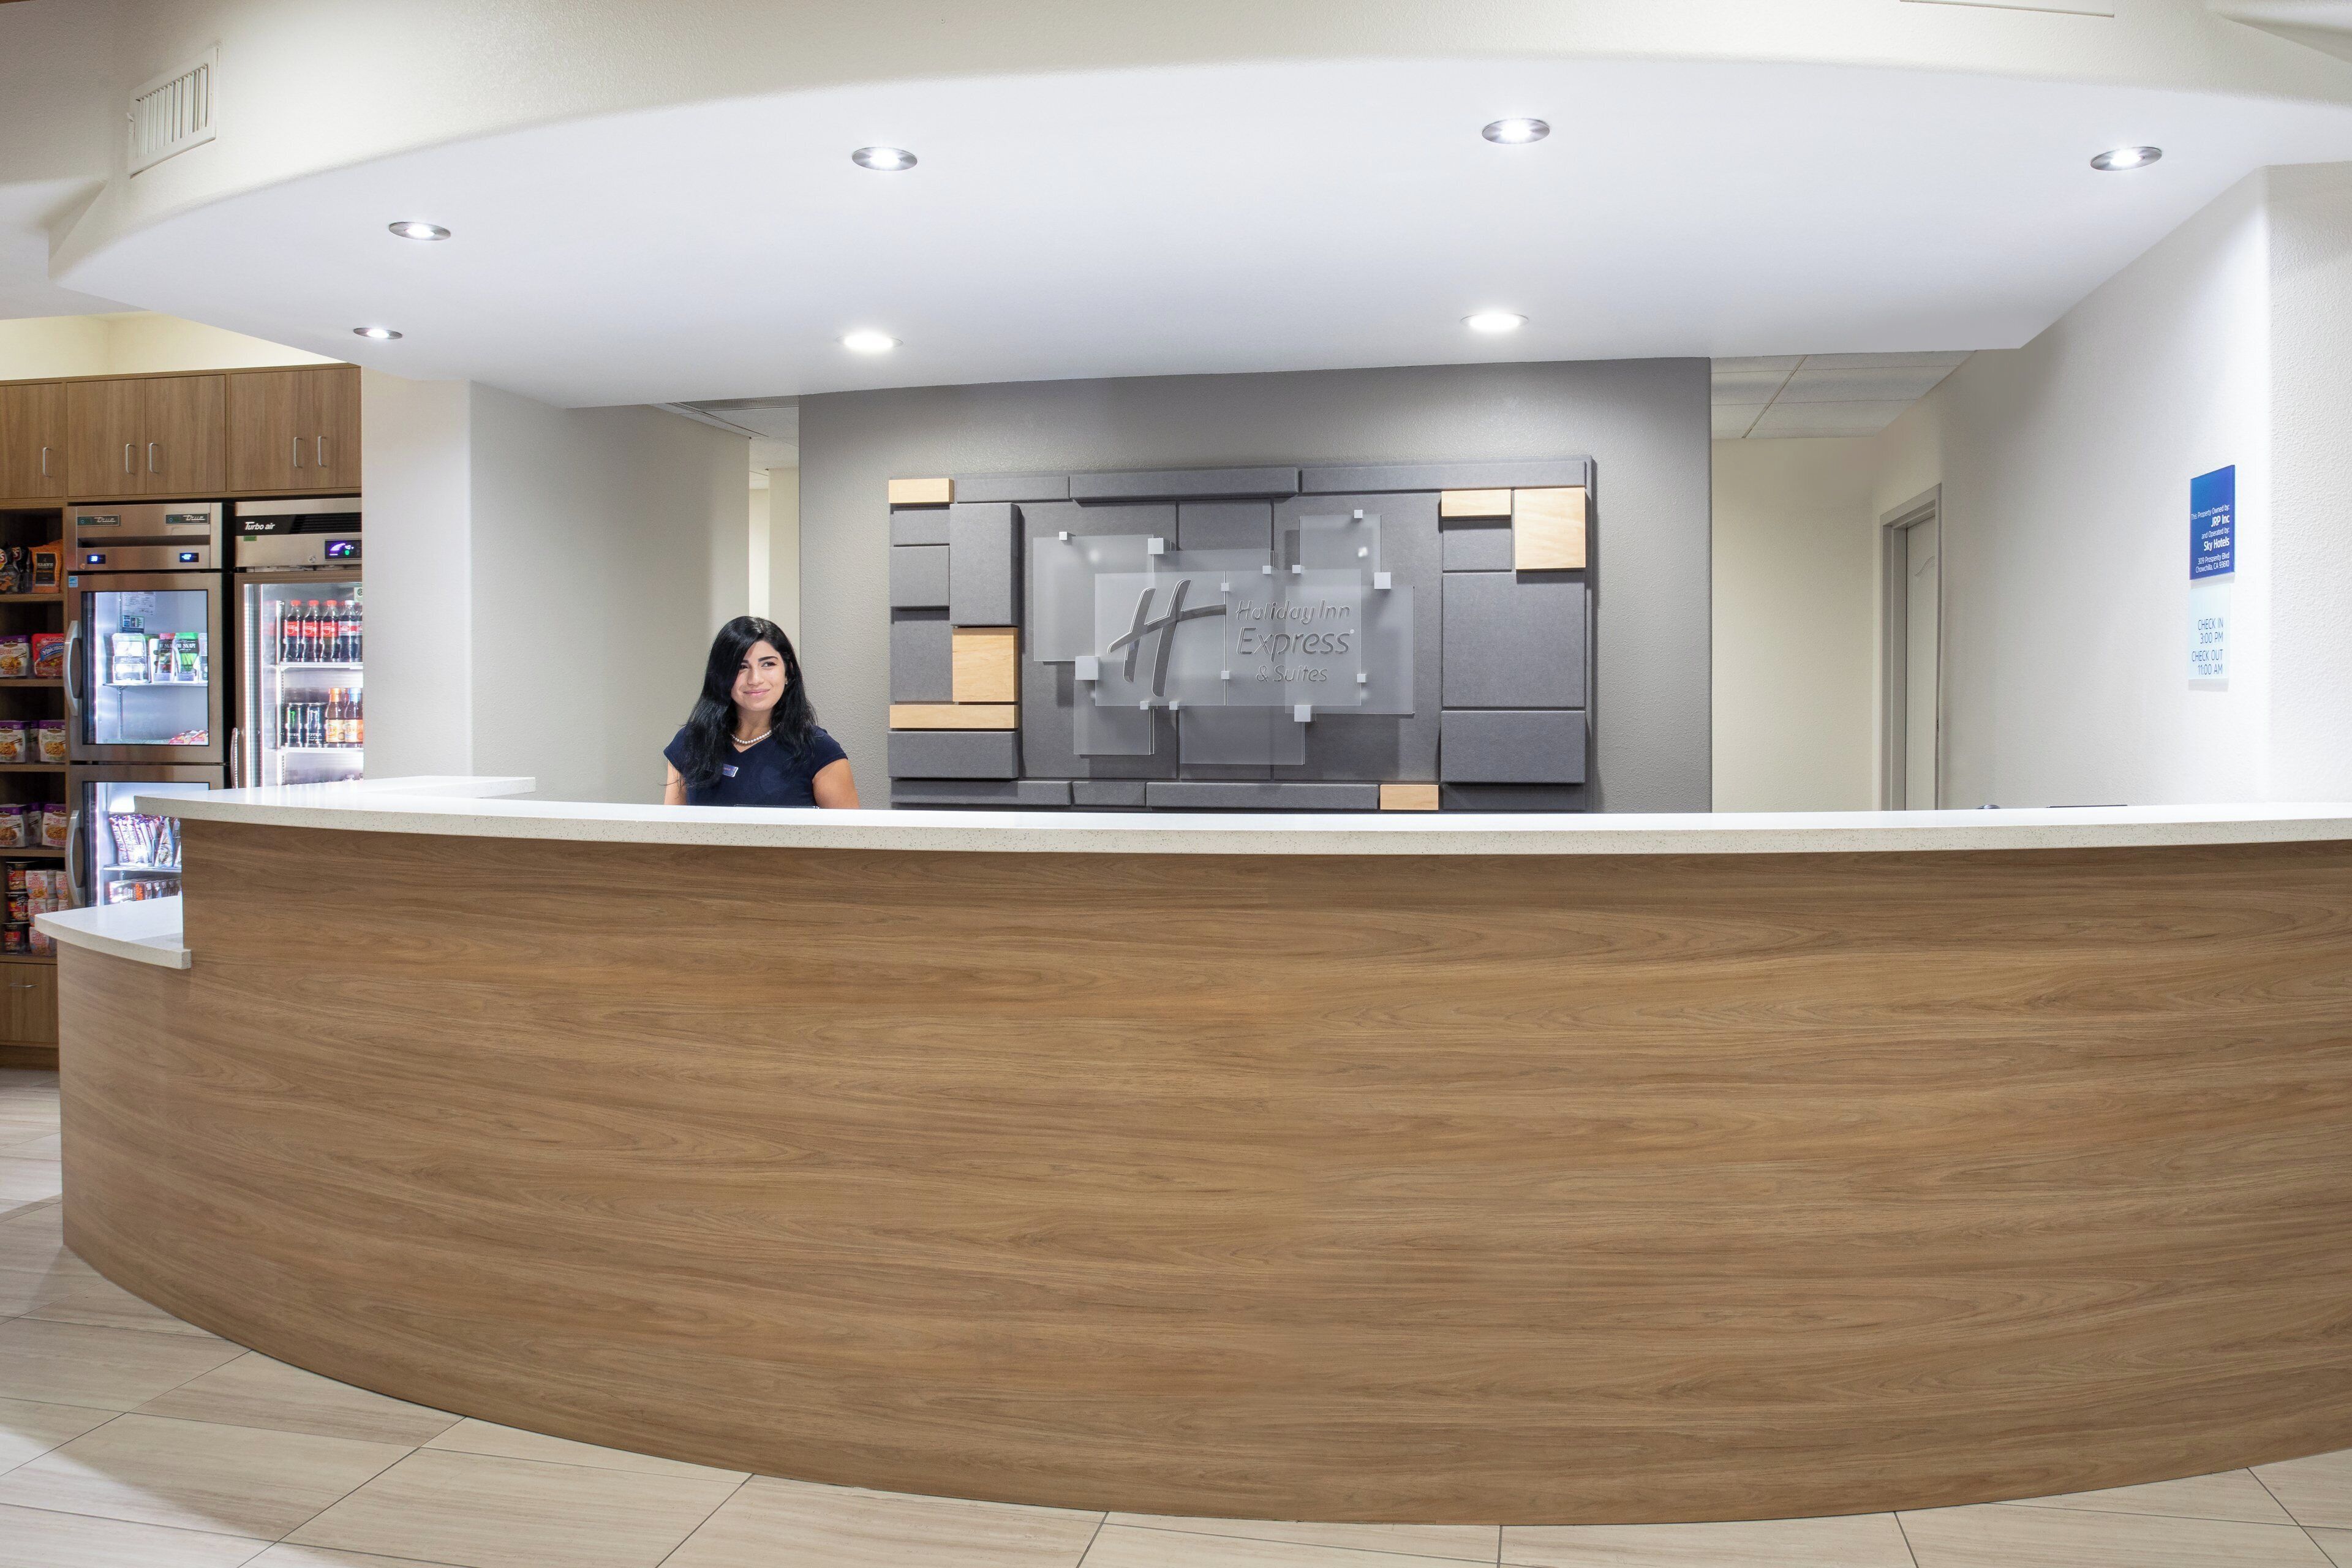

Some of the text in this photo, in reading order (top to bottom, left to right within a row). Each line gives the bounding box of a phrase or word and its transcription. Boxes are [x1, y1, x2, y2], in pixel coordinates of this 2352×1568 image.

[2198, 510, 2212, 518] Property
[2212, 505, 2224, 514] Owned
[245, 521, 264, 530] Turbo
[2211, 514, 2230, 527] JRP Inc
[2208, 529, 2224, 537] Operated
[2203, 536, 2230, 551] Sky Hotels
[2205, 554, 2221, 563] Prosperity
[2195, 564, 2213, 573] Chowchilla,
[2218, 560, 2230, 568] 93610
[1235, 599, 1351, 625] Holiday Inn
[2198, 617, 2223, 630] CHECK IN
[2200, 631, 2223, 644] 3:00 PM
[1236, 627, 1351, 662] Express
[2192, 649, 2223, 662] CHECK OUT
[1256, 665, 1328, 682] & Suites
[2198, 663, 2223, 675] 11:00 AM
